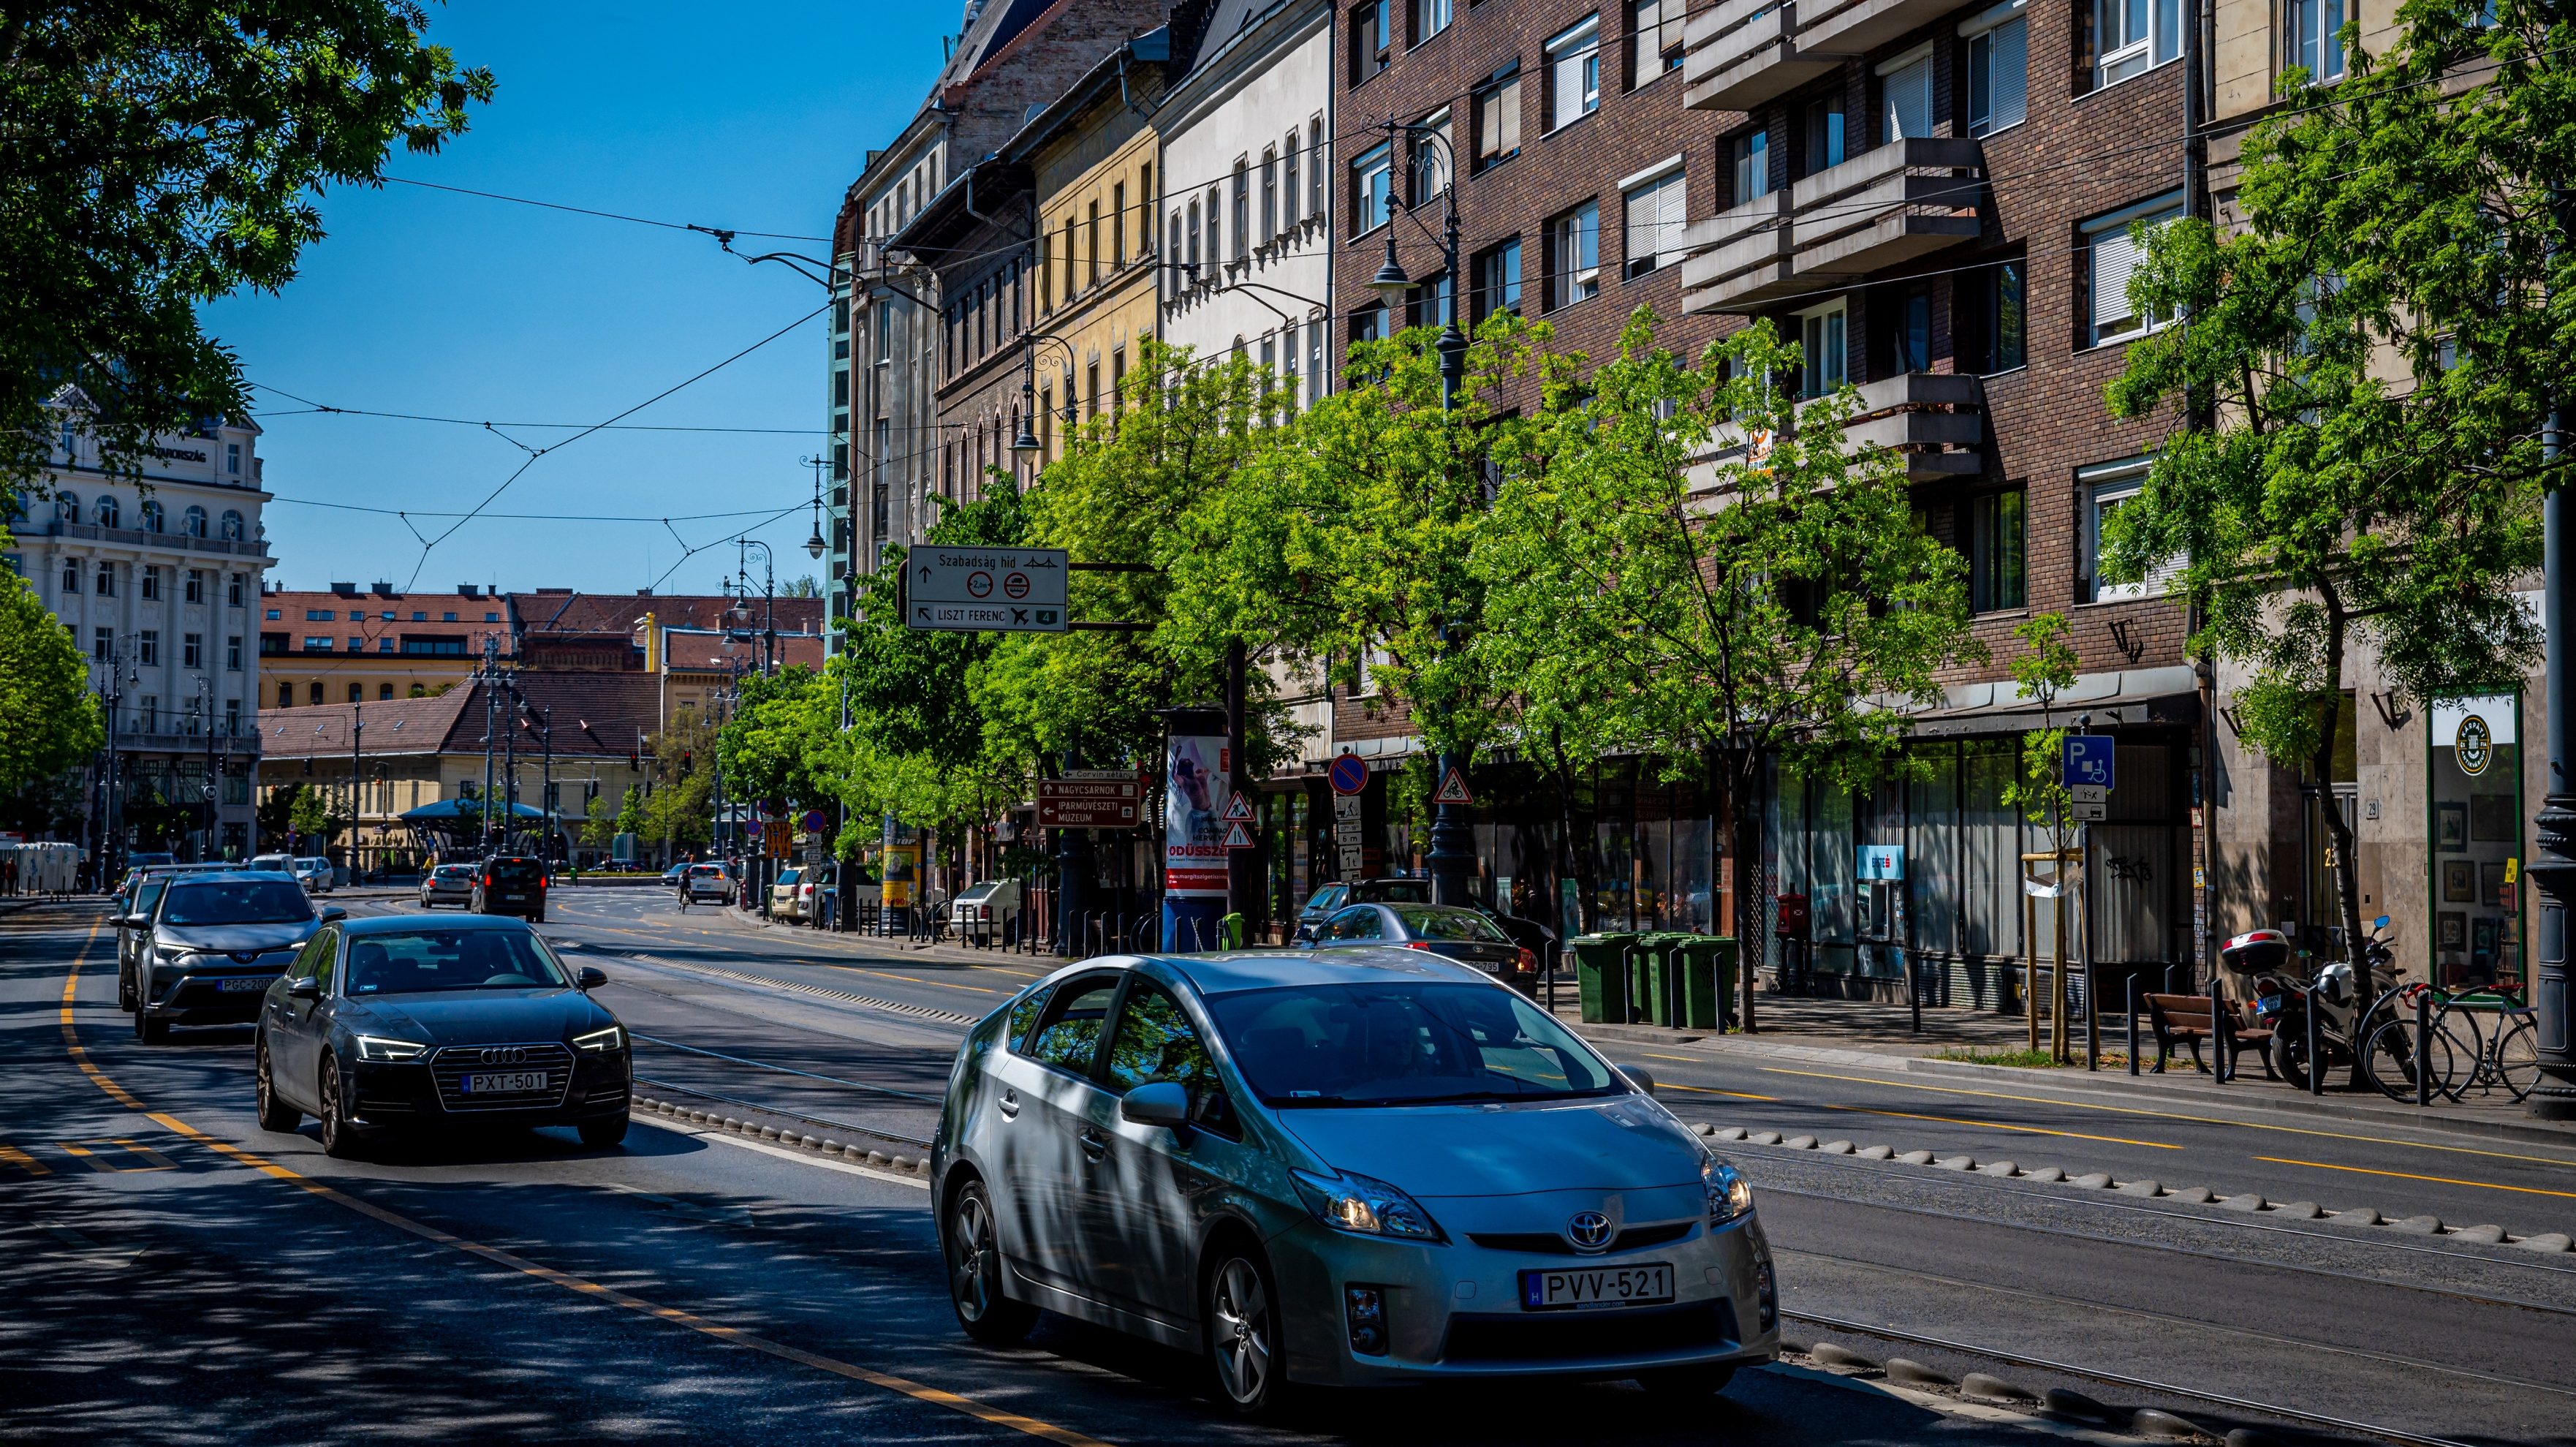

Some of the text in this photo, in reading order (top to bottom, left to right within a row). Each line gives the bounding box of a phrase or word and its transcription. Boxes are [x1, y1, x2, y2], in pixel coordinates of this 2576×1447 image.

[939, 554, 996, 571] Szabadság
[938, 609, 1050, 622] LISZT FERENC 4
[2461, 722, 2485, 738] KÁRPÁTI
[2069, 742, 2086, 766] P
[2461, 749, 2486, 768] ANTIKVÁRIUM
[1077, 770, 1104, 778] Corvin
[1058, 785, 1115, 795] NAGYCSARNOK
[2368, 803, 2376, 816] 29
[1058, 811, 1092, 823] MÚZEUM
[1872, 858, 1884, 868] ERSTE
[224, 980, 270, 989] PGC-200
[474, 1074, 542, 1090] PXT-501
[1531, 1269, 1664, 1302] H PVV-521
[1576, 1301, 1626, 1310] sandlander.com
